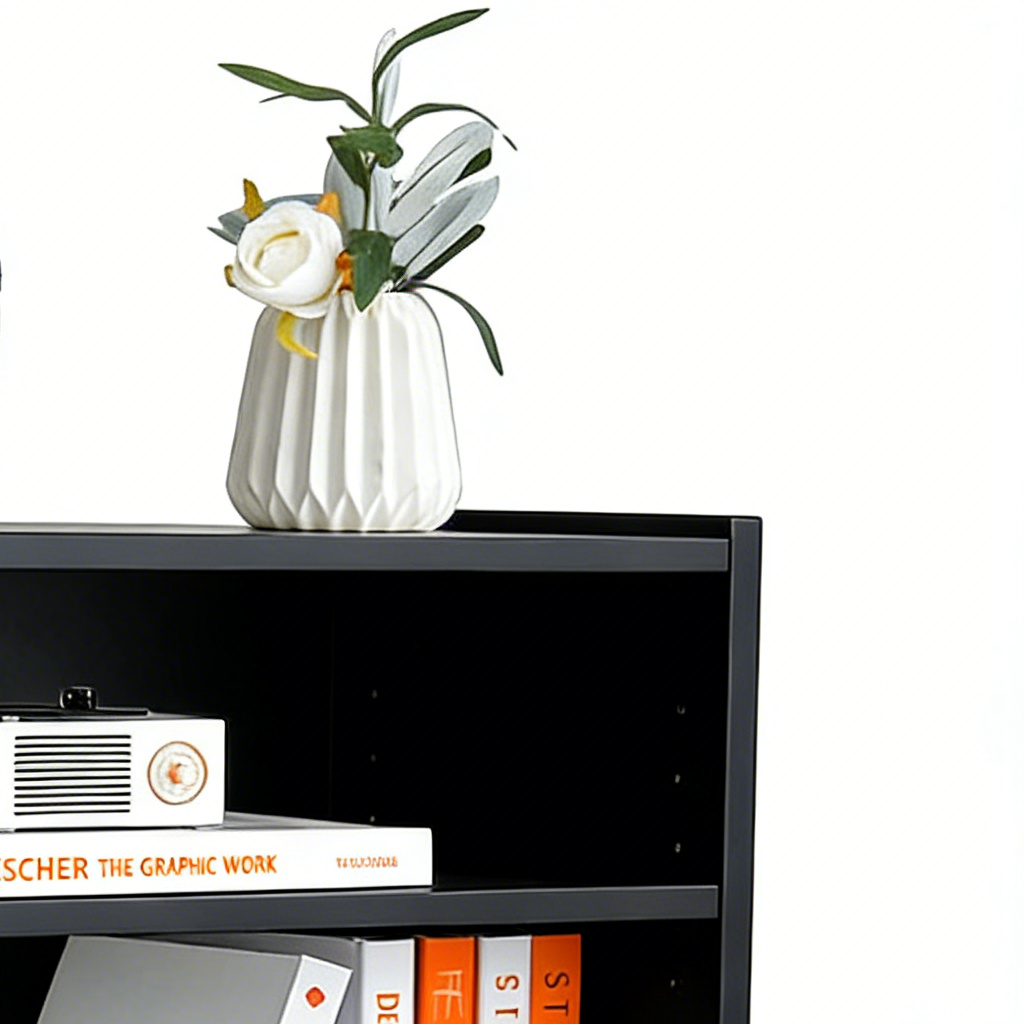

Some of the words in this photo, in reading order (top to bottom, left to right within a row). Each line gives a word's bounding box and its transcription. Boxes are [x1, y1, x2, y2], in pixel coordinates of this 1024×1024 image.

[97, 857, 135, 878] THE
[139, 855, 218, 877] GRAPHIC
[222, 854, 278, 875] WORK
